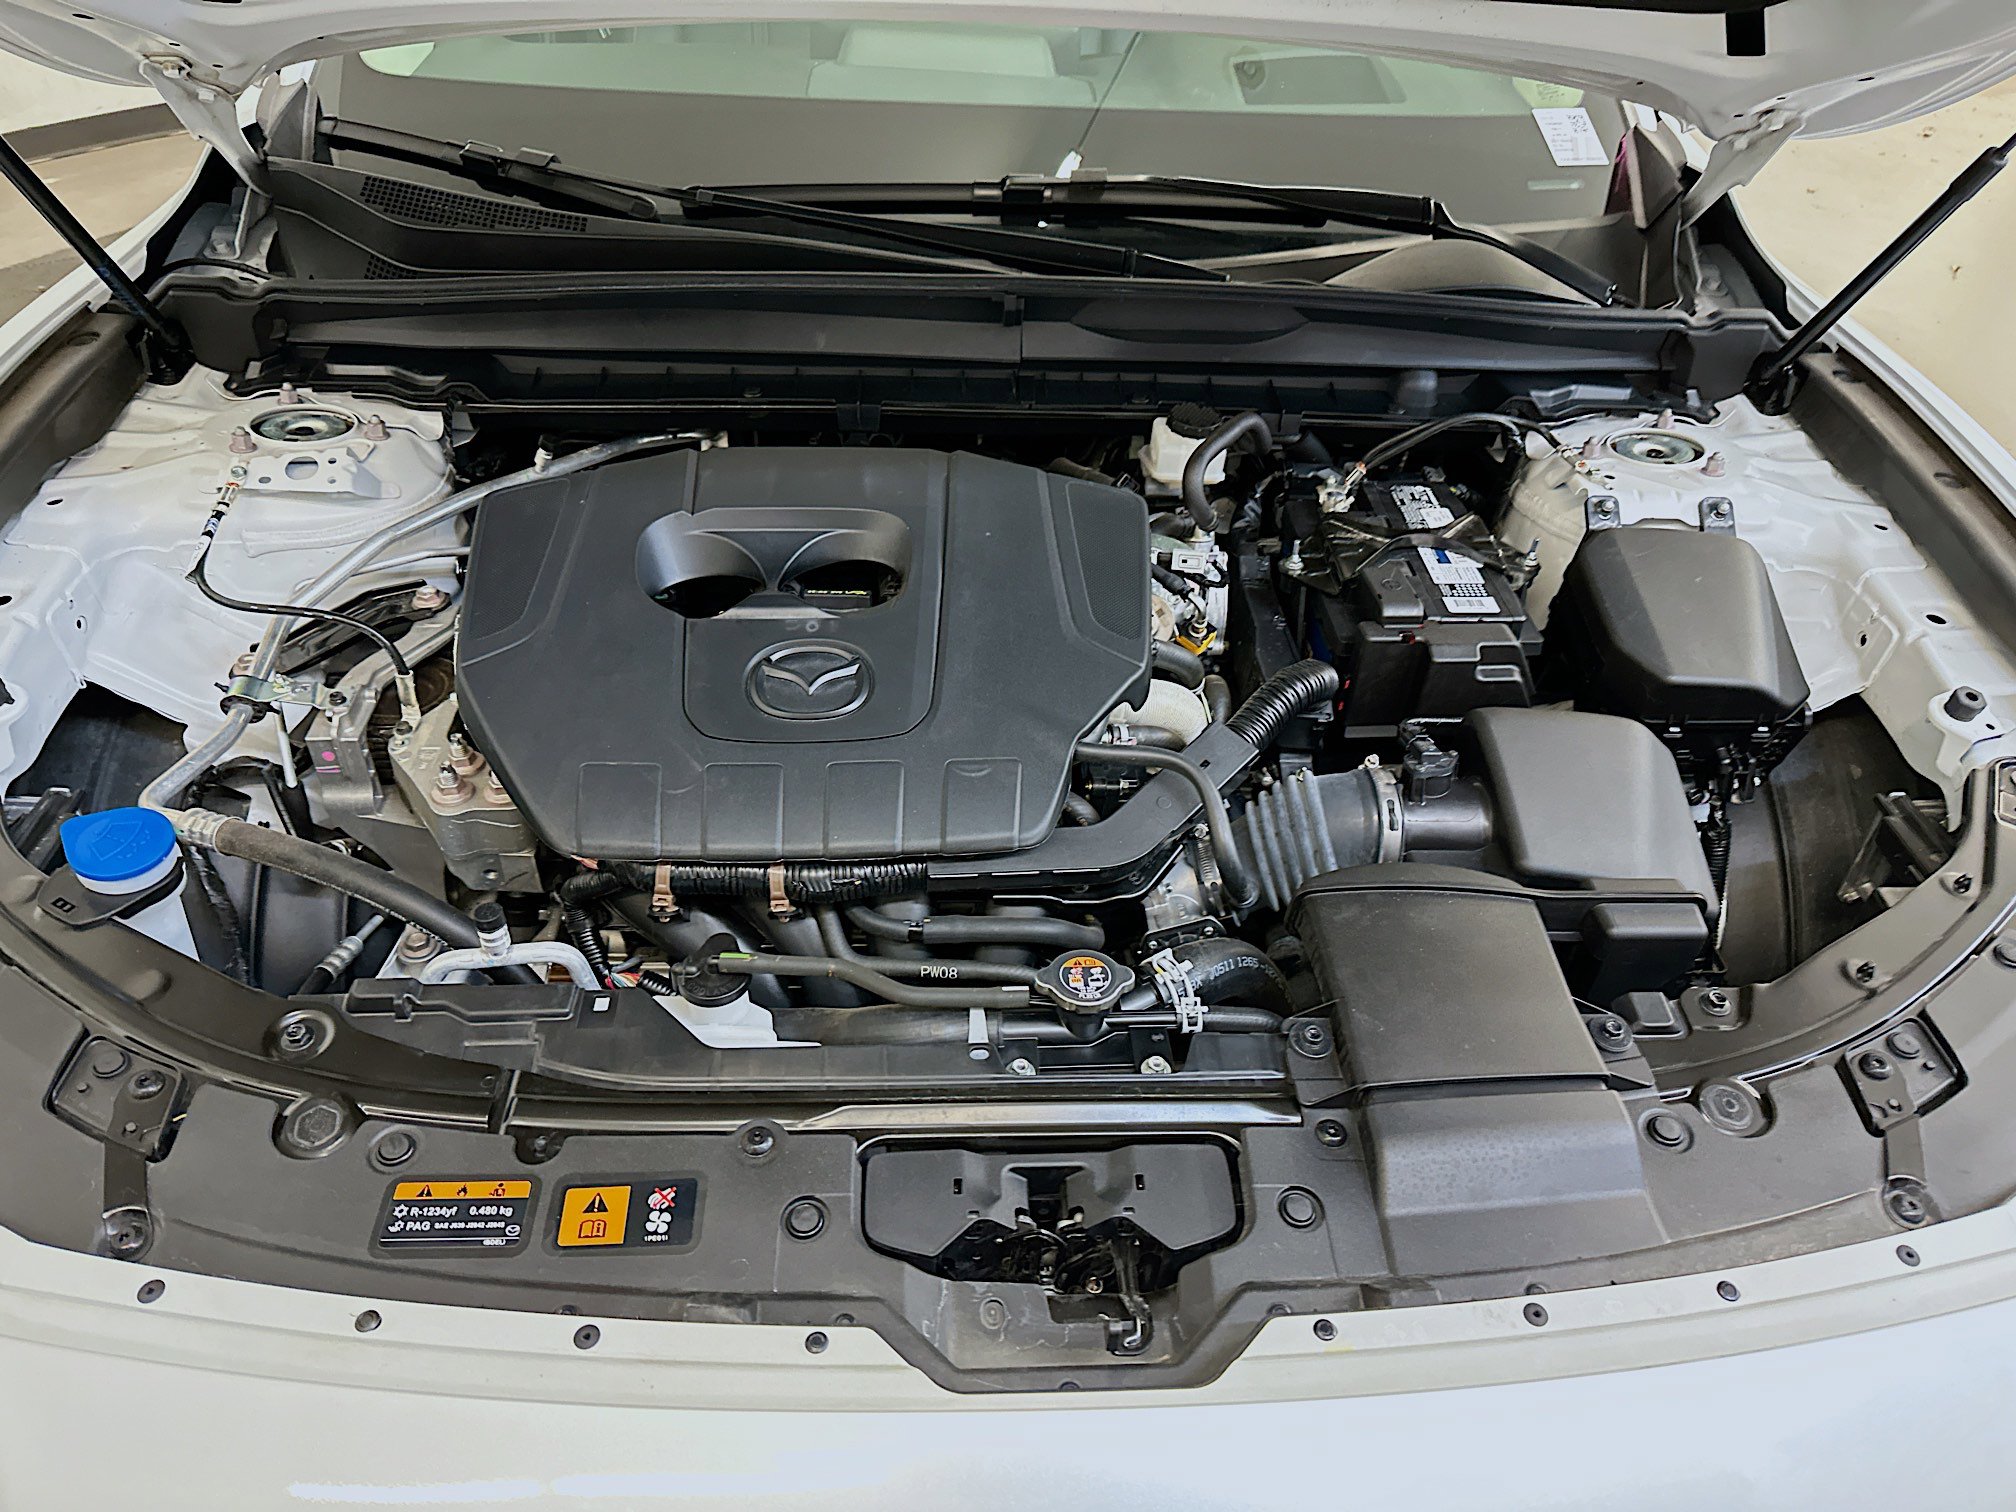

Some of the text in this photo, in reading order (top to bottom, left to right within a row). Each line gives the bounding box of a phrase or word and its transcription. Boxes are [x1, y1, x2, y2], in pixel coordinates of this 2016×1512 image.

[920, 965, 958, 980] PW08
[410, 1205, 513, 1218] R-1234yf 0.480 kg
[405, 1221, 431, 1231] PAG
